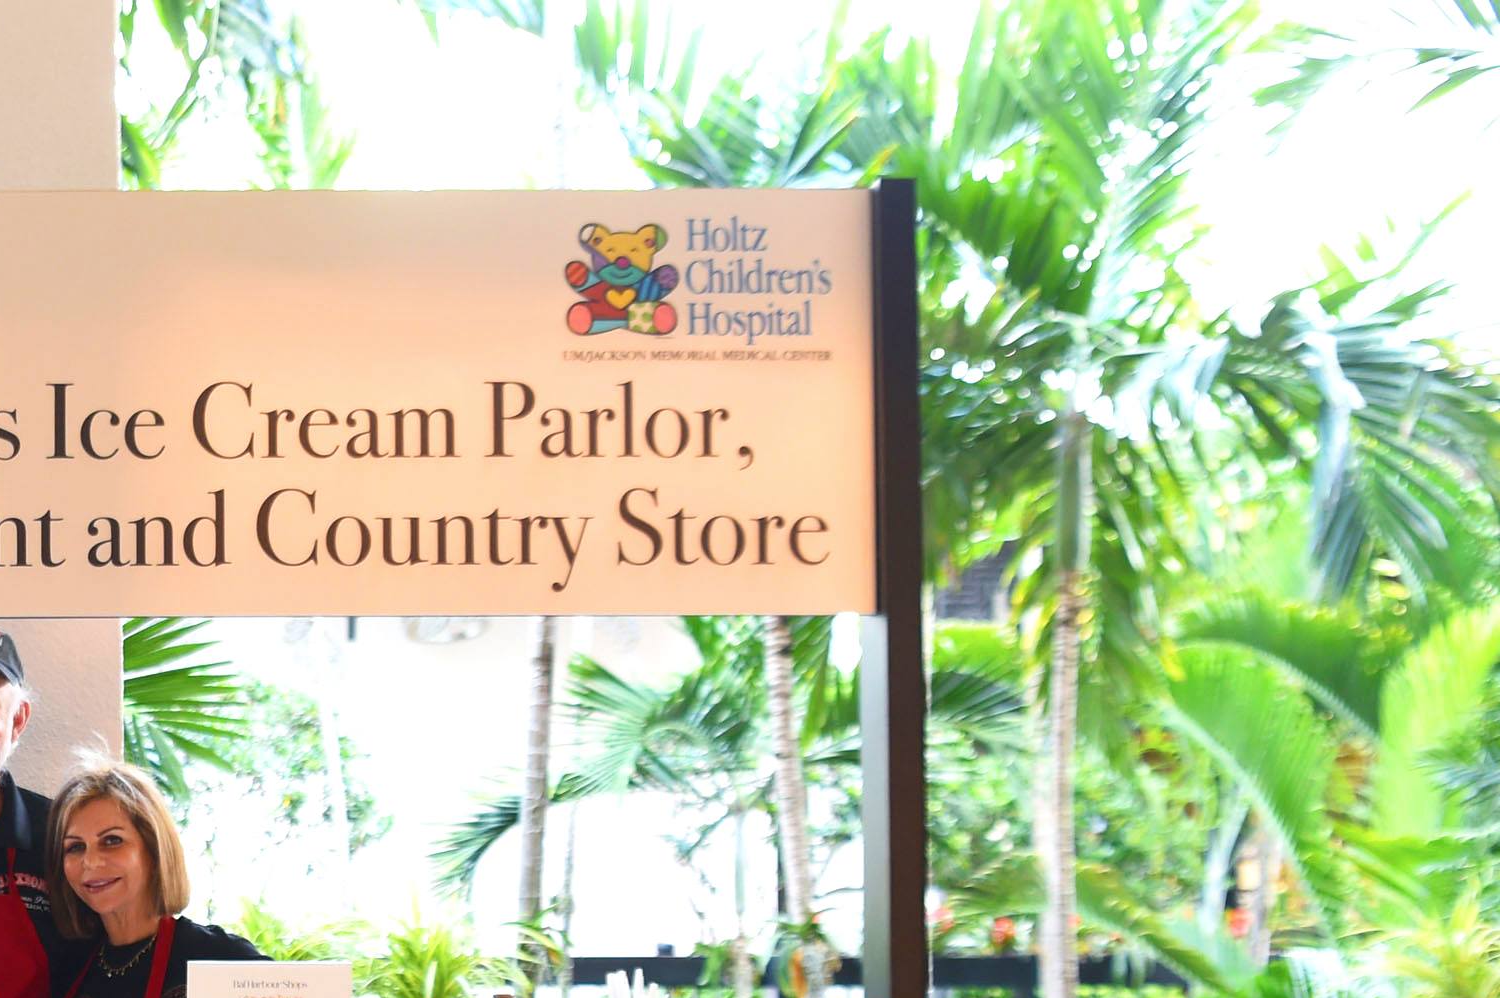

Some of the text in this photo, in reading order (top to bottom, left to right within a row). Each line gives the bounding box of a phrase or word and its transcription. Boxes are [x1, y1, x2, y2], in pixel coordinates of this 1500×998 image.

[686, 216, 769, 252] Holtz
[685, 258, 833, 296] Children's
[687, 300, 812, 345] Hospital
[563, 350, 833, 363] UM/JACKSON MEMORIAL MEDICAL CENTER
[45, 382, 166, 460] Ice
[192, 380, 462, 460] Cream
[483, 380, 756, 471] Parlor,
[86, 488, 232, 567] and
[255, 486, 595, 593] Country
[616, 486, 832, 566] Store
[281, 979, 308, 991] Shops
